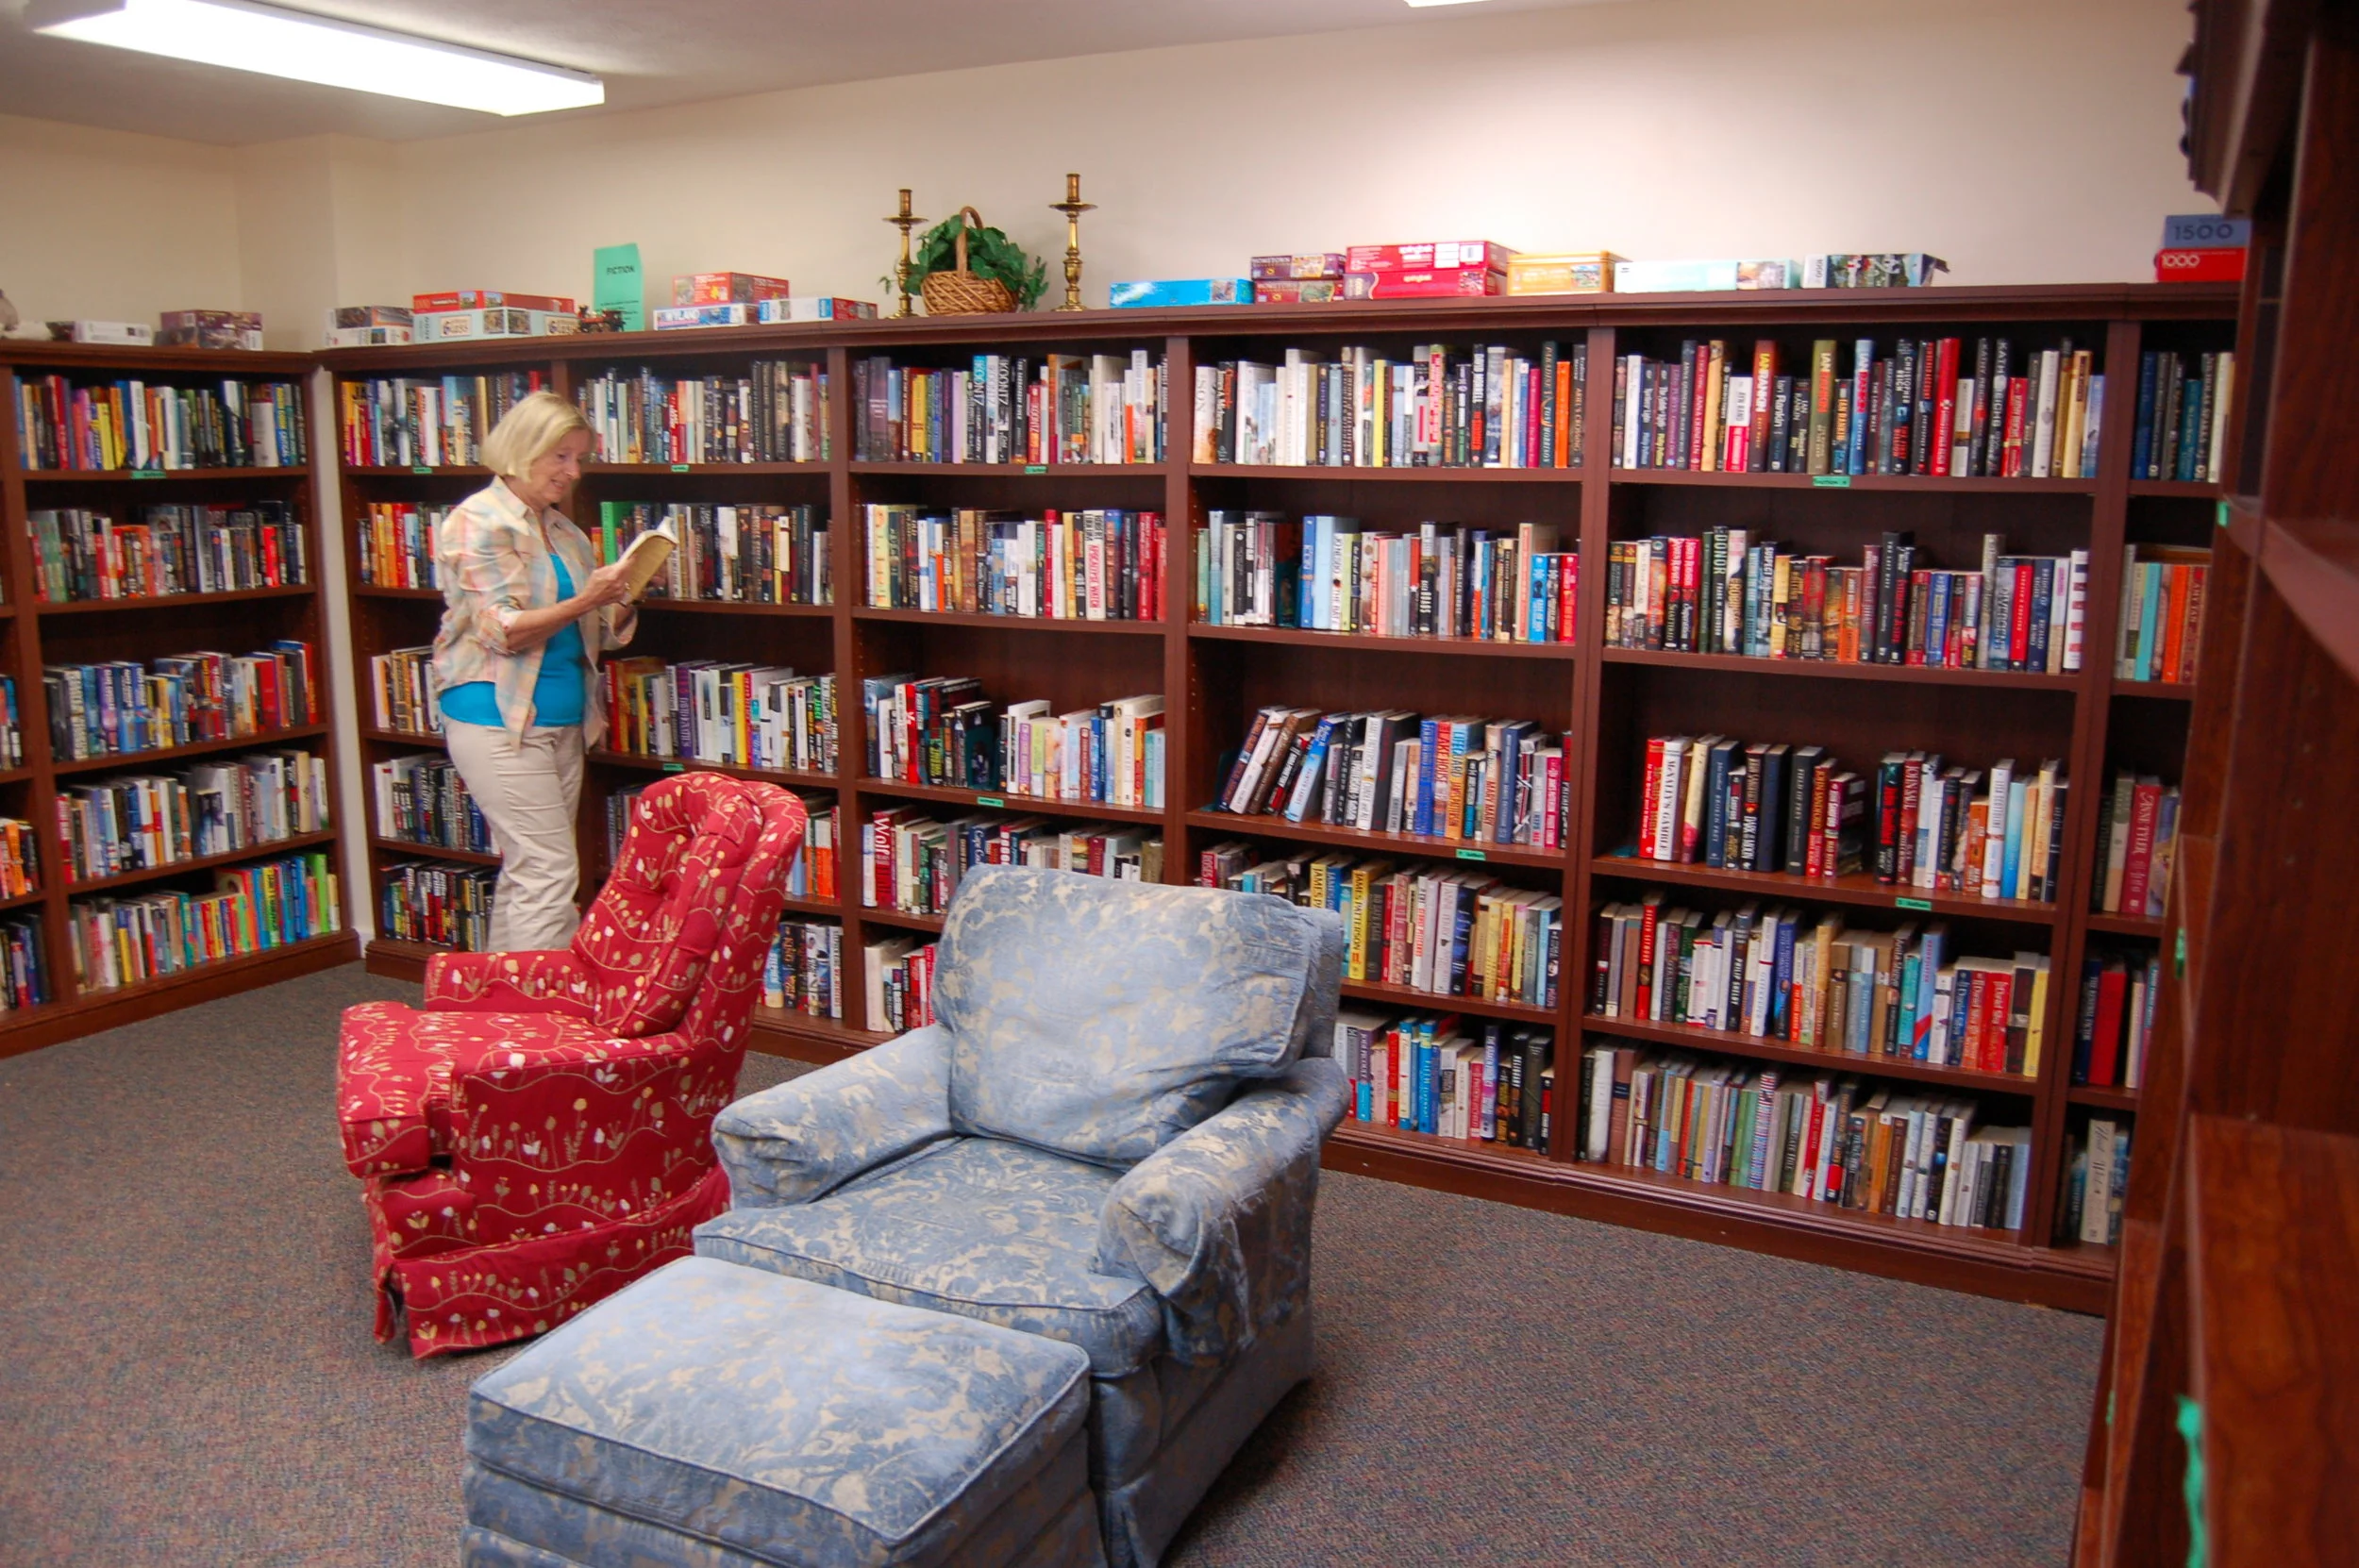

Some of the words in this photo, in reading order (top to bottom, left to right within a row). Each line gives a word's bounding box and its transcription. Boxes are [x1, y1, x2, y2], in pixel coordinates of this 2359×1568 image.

[2175, 224, 2234, 240] 1500
[607, 266, 636, 275] FICTION
[2162, 255, 2200, 268] 1000
[1759, 353, 1770, 371] IAN
[974, 363, 985, 406] KOONTZ
[998, 362, 1008, 406] KOONTZ
[1755, 371, 1769, 412] RANKIN
[1777, 379, 1786, 393] Ian
[1902, 357, 1913, 404] CHRISTOPHER
[1774, 395, 1786, 426] Rankin
[1089, 545, 1099, 583] APOCALYPSE
[1713, 535, 1727, 575] DONOR
[1090, 587, 1101, 608] WATCH
[1994, 587, 2011, 651] DIVERGENT
[2189, 605, 2200, 624] TAN
[1438, 730, 1449, 757] LAKE
[1451, 731, 1464, 777] LIFEGUARD
[1435, 759, 1448, 784] HOUSE
[1797, 769, 1805, 790] FIELD
[1815, 771, 1826, 791] JOHN
[1905, 765, 1918, 789] JOHN
[1486, 781, 1496, 802] MARY
[1796, 792, 1803, 801] OF
[1903, 790, 1917, 810] SAUL
[1484, 804, 1495, 826] MARY
[1794, 803, 1803, 820] PREY
[2138, 792, 2154, 824] ANNE
[1660, 812, 1673, 851] GAMBLE
[1743, 816, 1757, 833] DARK
[874, 817, 890, 855] Wolf
[972, 830, 985, 847] Cape
[2132, 826, 2150, 855] TYLER
[1741, 840, 1755, 859] MOON
[1201, 855, 1213, 877] ROSES
[1313, 868, 1325, 898] JAMES
[1354, 873, 1364, 900] JAMES
[1352, 902, 1362, 950] PATTERSON
[1733, 959, 1742, 978] PHILIP
[1731, 982, 1741, 1005] SHELBY
[1955, 988, 1967, 1014] Daniel
[1971, 986, 1982, 1008] Daniel
[1953, 1017, 1964, 1035] Silva
